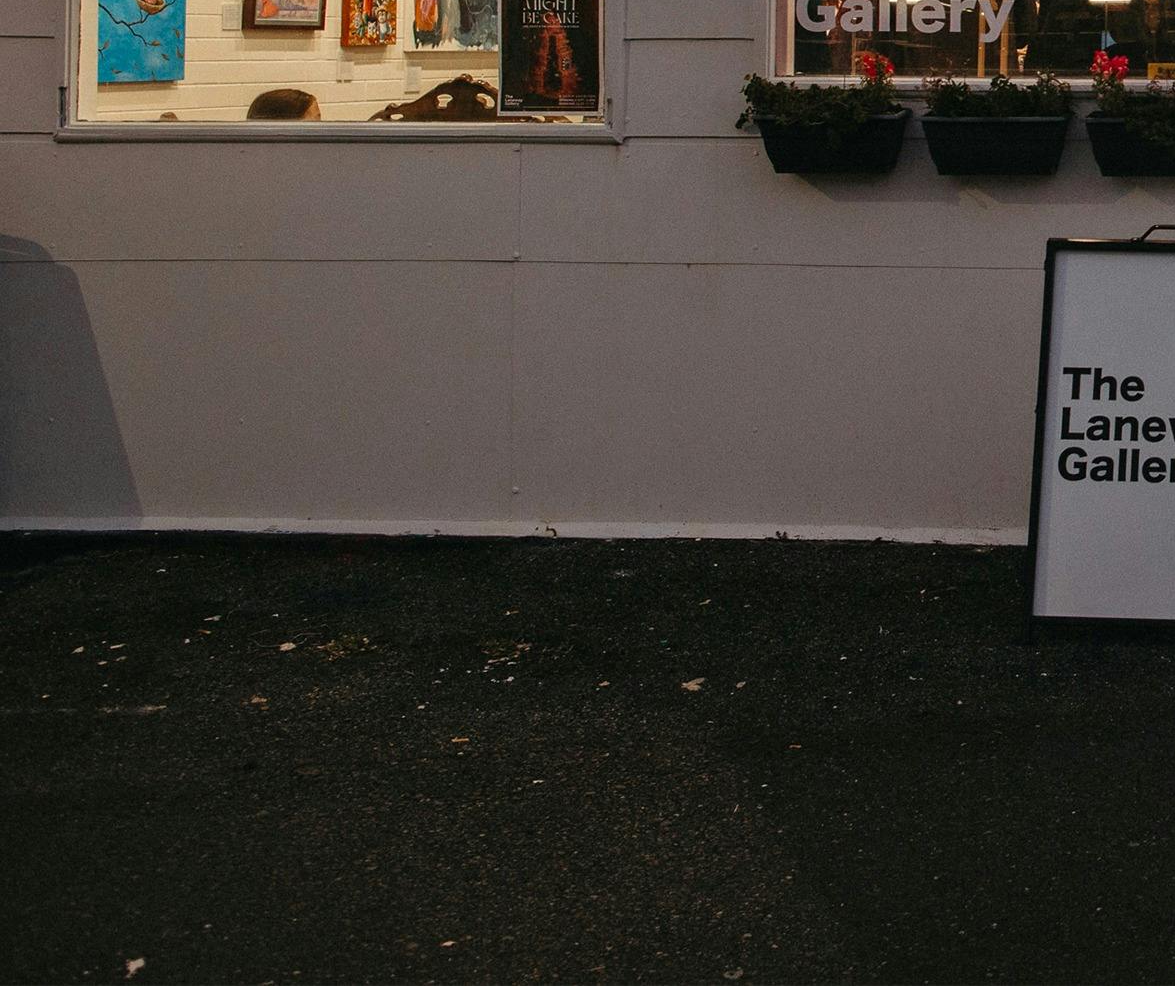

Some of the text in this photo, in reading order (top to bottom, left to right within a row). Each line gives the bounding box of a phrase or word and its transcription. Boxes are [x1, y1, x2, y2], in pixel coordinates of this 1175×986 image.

[522, 12, 580, 24] BE CAKE
[1063, 367, 1145, 402] The
